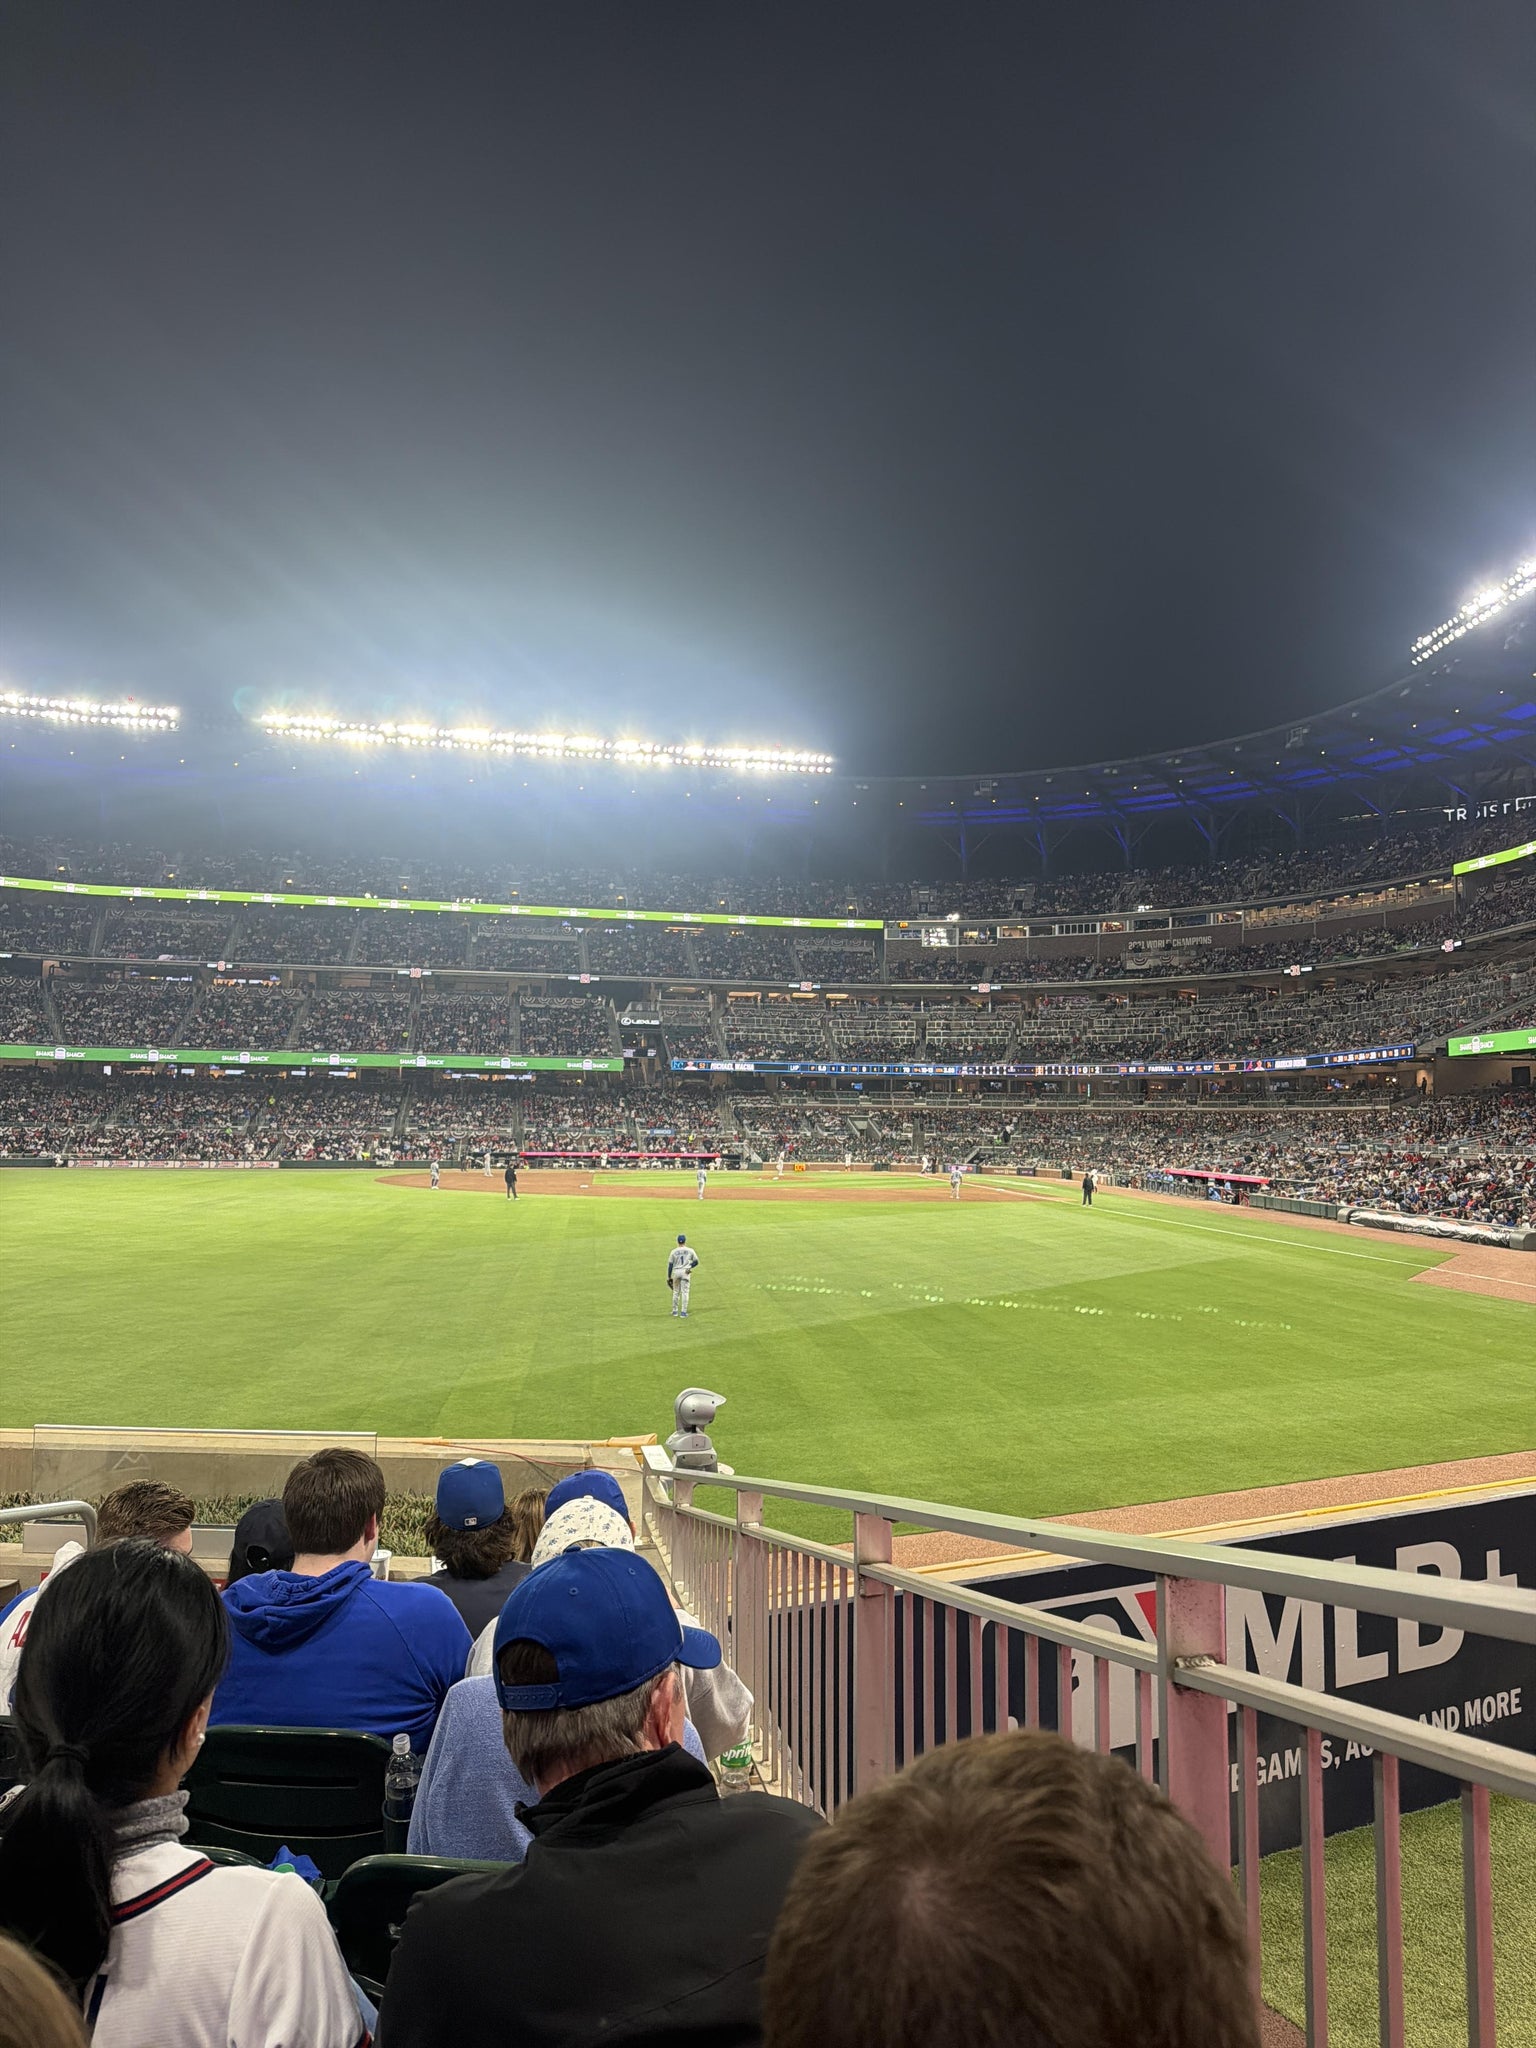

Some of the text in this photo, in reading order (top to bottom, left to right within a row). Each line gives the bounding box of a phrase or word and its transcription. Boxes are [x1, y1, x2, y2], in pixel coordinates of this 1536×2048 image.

[1172, 936, 1212, 947] CHAMPIONS
[1256, 1740, 1340, 1785] GAMS,
[1464, 1687, 1522, 1729] MORE
